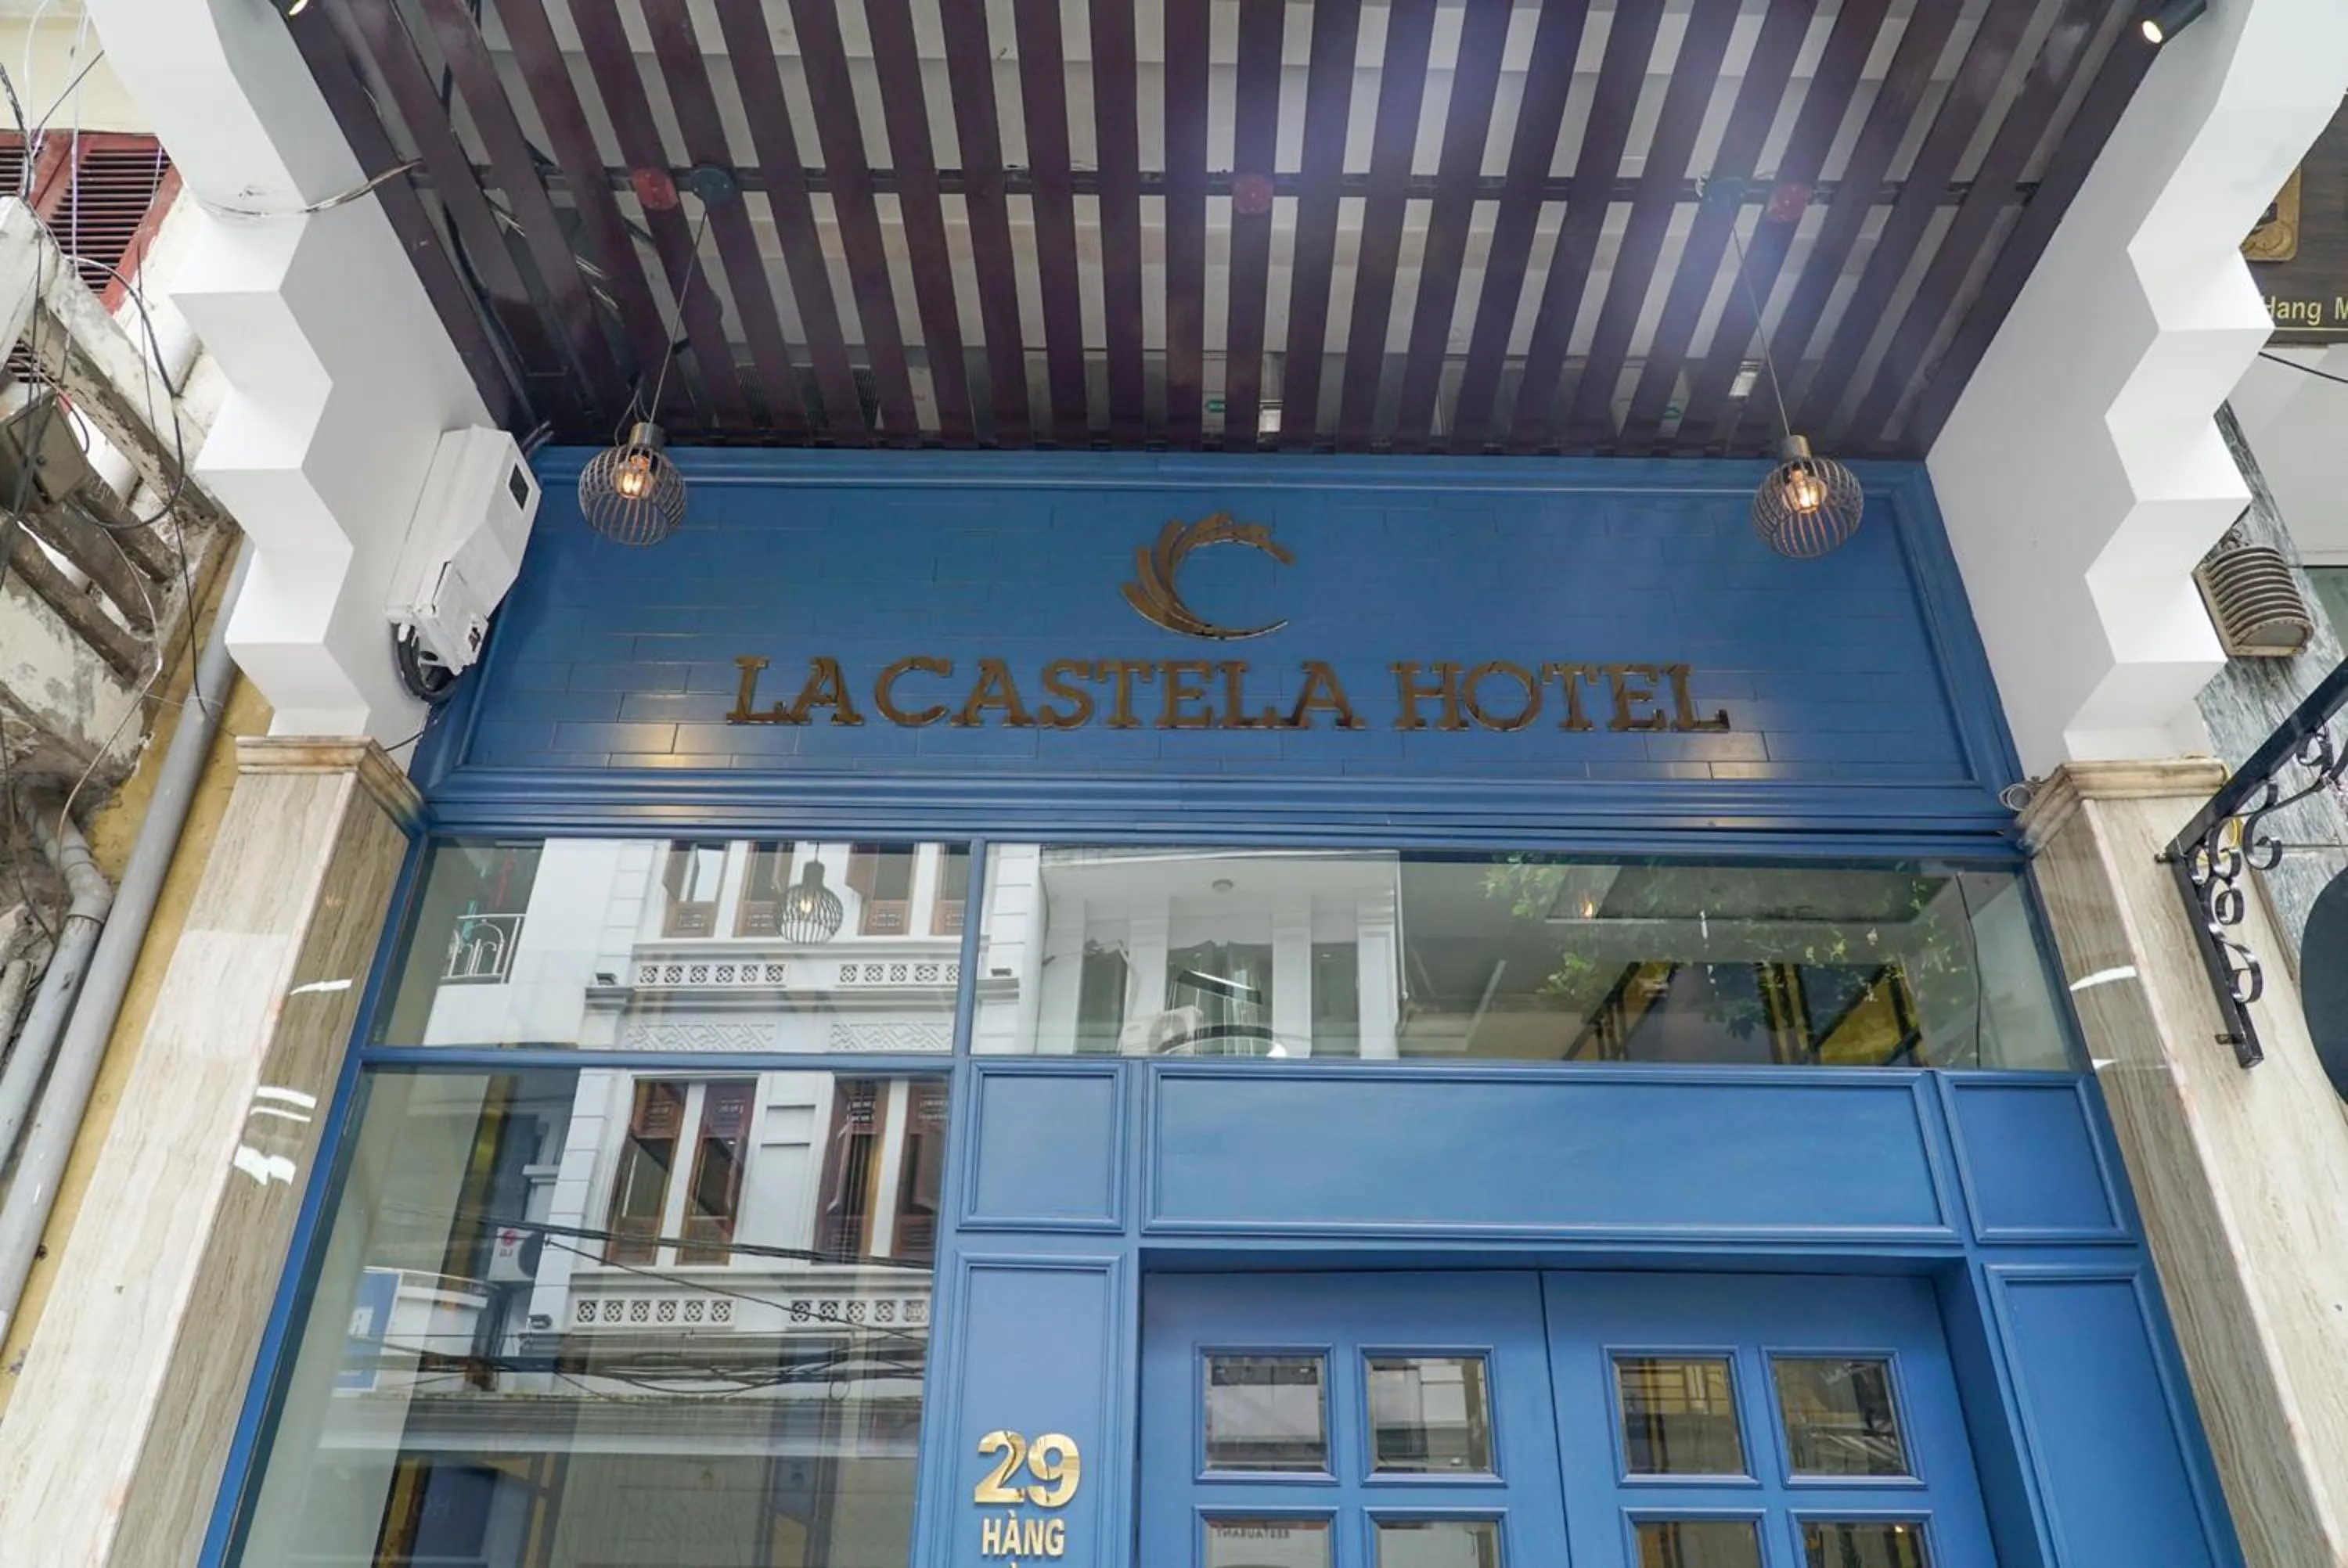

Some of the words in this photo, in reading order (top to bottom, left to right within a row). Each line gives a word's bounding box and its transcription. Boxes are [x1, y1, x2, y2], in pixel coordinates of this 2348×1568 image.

[726, 656, 1365, 730] LACASTELA
[1389, 660, 1730, 733] HOTEL
[974, 1430, 1080, 1508] 29
[981, 1509, 1065, 1557] HÀNG
